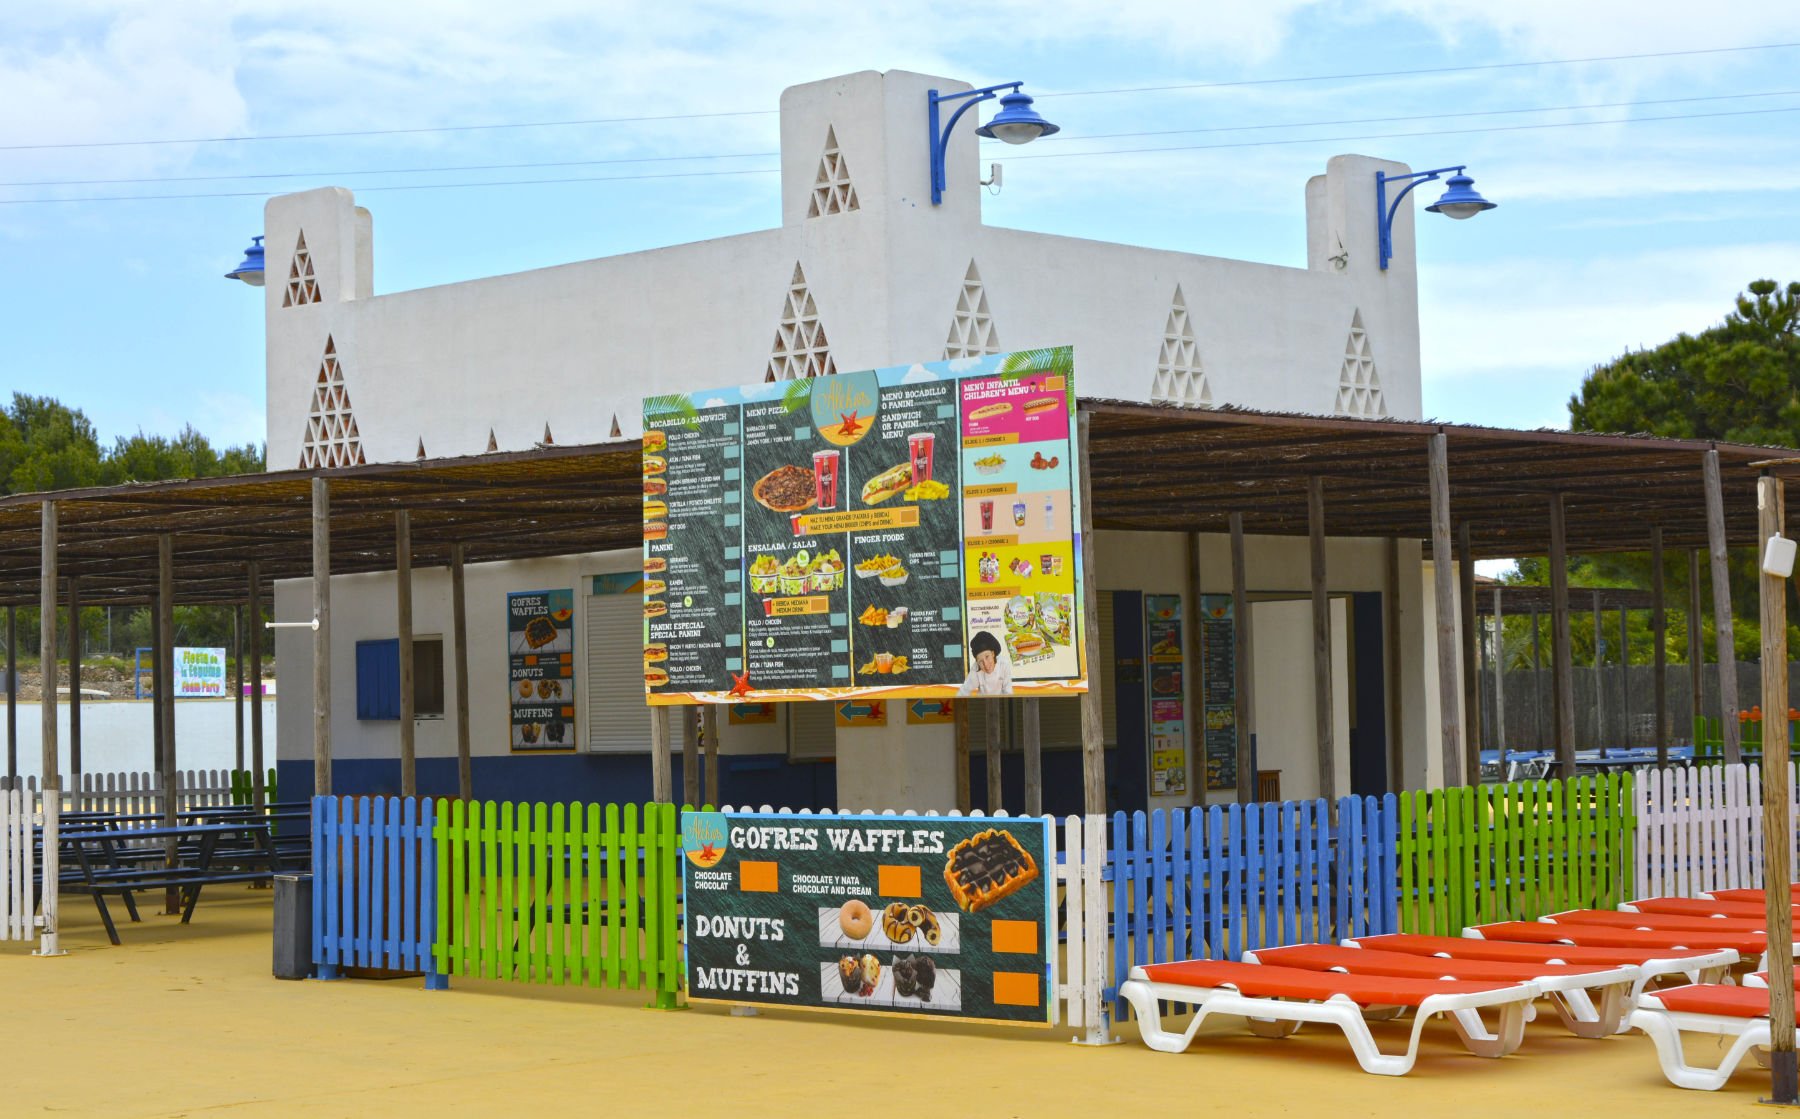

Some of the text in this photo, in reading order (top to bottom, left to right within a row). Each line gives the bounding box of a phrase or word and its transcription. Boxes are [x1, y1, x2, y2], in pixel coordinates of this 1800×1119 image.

[987, 379, 1020, 390] INFANTIL
[905, 387, 946, 398] BOCADILLO
[964, 386, 1029, 400] CHILDREN'S MENU
[889, 400, 914, 409] PANINI
[768, 406, 788, 415] PIZZA
[650, 418, 685, 428] BOCADILLO
[692, 413, 726, 424] SANDWICH
[882, 411, 921, 422] SANDWICH
[894, 420, 919, 429] PANINI
[882, 430, 903, 439] MENU
[855, 534, 904, 544] FINGER FOODS
[748, 542, 786, 552] ENSALADA
[512, 597, 541, 607] GOFRES
[512, 606, 548, 616] WAFFLES
[183, 651, 208, 664] Fiesta
[189, 664, 221, 678] Espuma
[512, 668, 543, 678] DONUTS
[182, 681, 220, 693] Foam Party
[513, 708, 553, 718] MUFFINS
[731, 826, 944, 853] GOFRES WAFFLES
[695, 872, 732, 880] CHOCOLATE
[792, 874, 859, 885] CHOCOLATE Y NATA
[695, 881, 728, 890] CHOCOLAT
[792, 884, 871, 896] CHOCOLAT AND CREAM
[696, 914, 784, 940] DONUTS
[736, 944, 750, 966] &
[697, 967, 799, 996] MUFFINS
